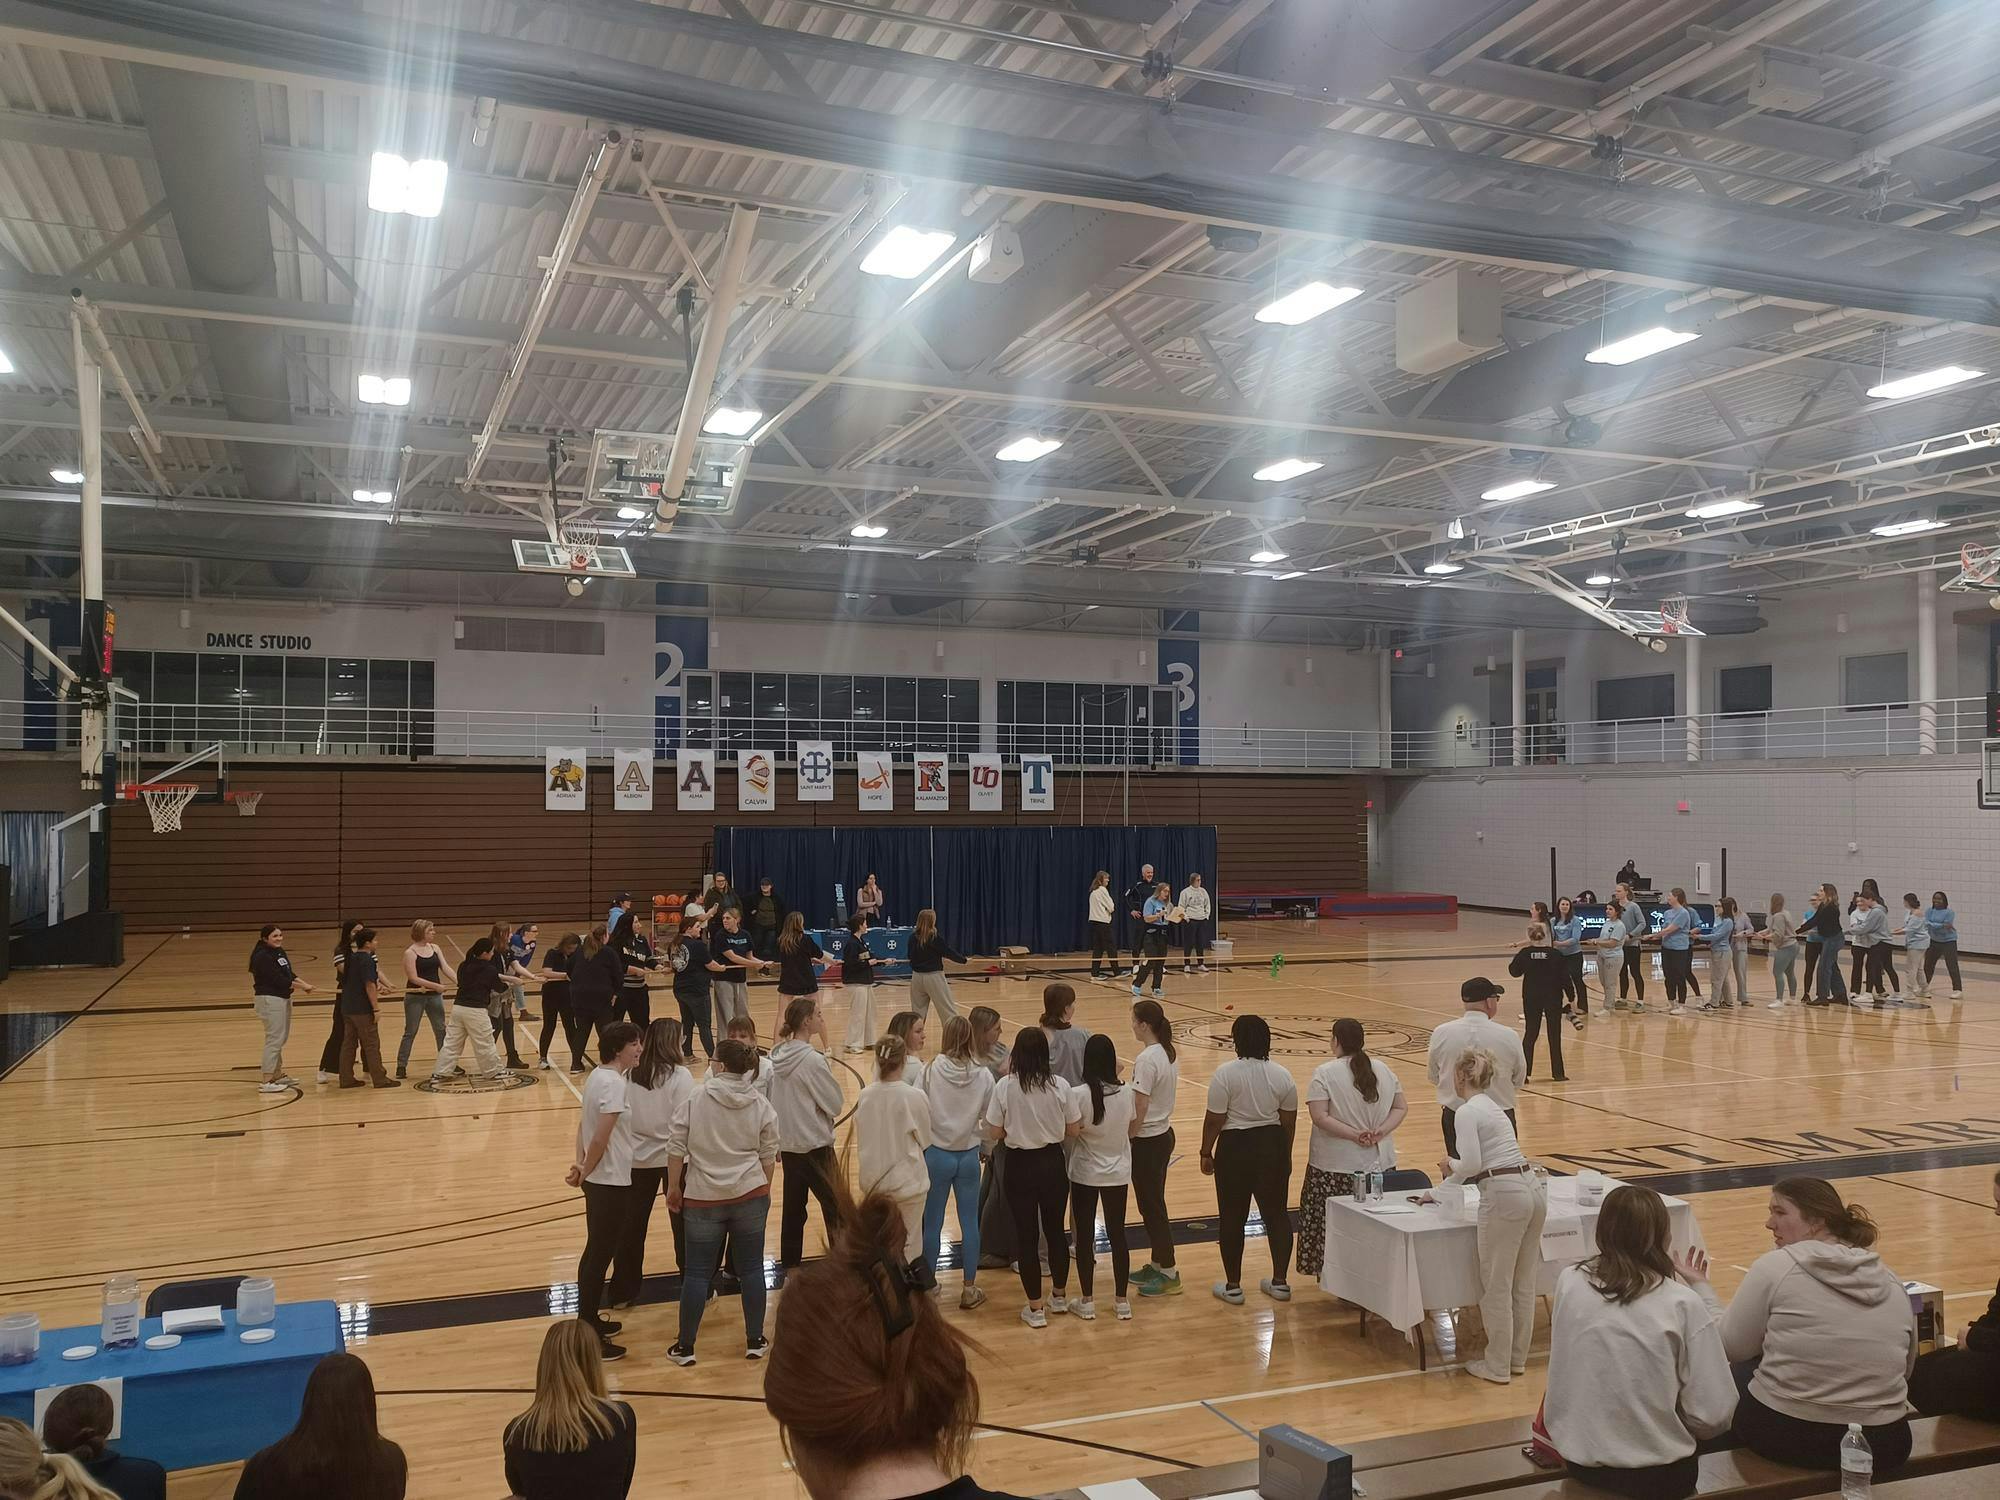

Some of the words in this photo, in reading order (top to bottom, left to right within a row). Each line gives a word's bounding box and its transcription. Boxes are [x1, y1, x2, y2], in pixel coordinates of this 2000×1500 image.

[206, 633, 253, 648] DANCE
[260, 634, 312, 650] STUDIO
[654, 641, 685, 697] 2
[1166, 662, 1196, 711] 3
[616, 760, 650, 792] A
[681, 760, 711, 791] A
[1022, 761, 1051, 794] T
